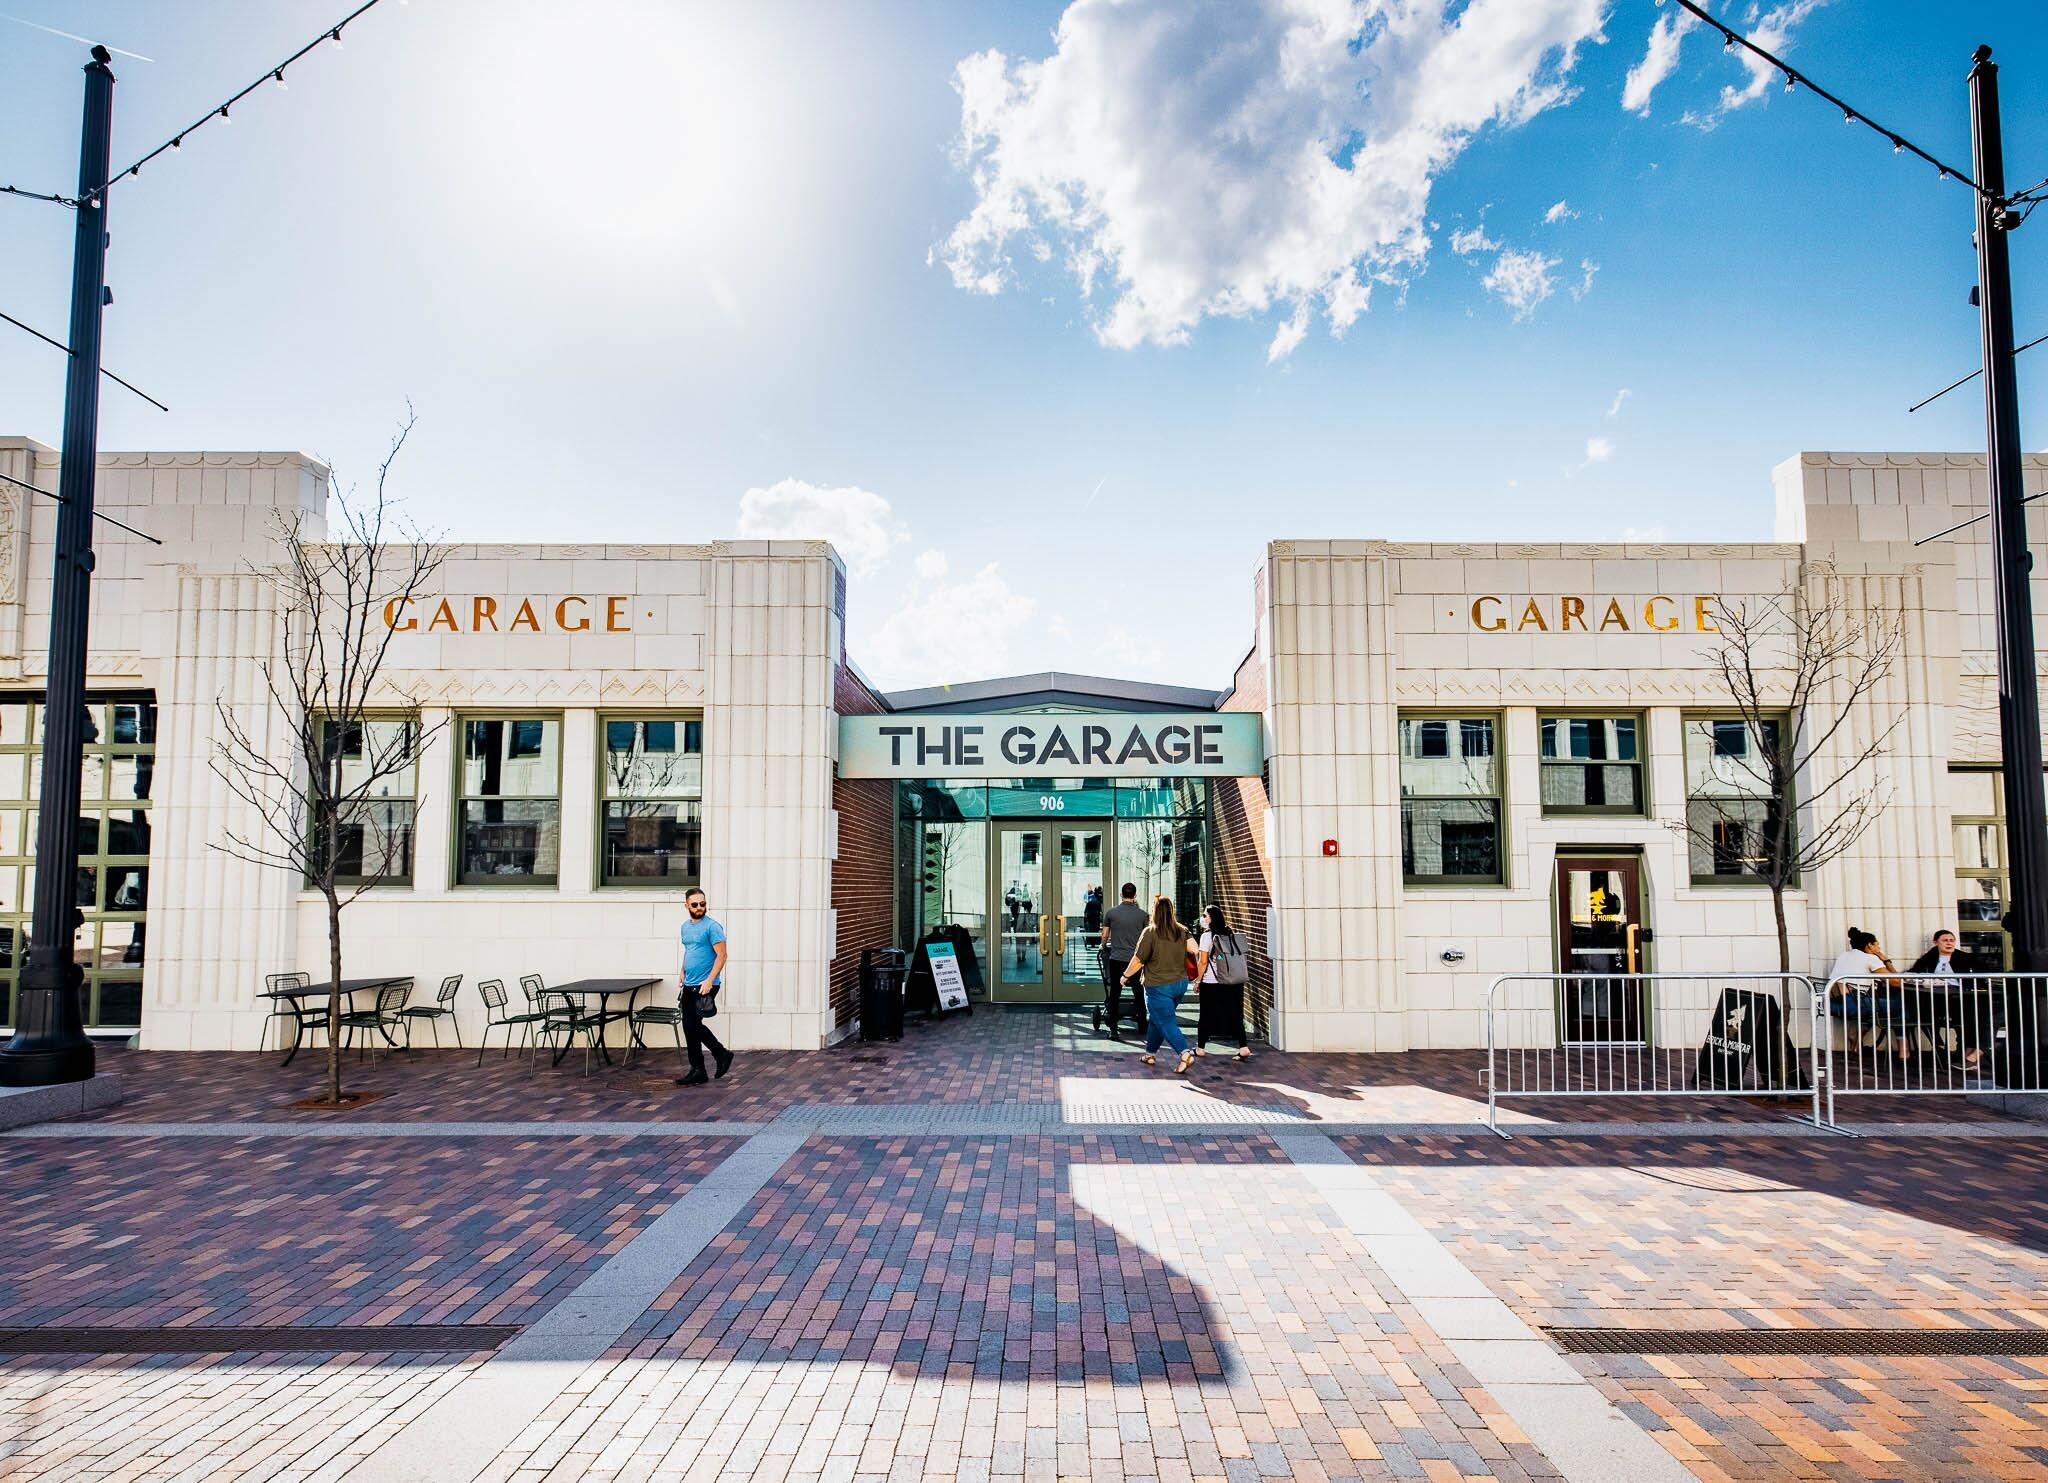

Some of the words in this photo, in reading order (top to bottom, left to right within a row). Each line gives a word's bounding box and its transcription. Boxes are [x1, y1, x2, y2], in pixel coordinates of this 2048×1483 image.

[383, 596, 631, 632] GARAGE
[1471, 596, 1720, 631] GARAGE
[879, 726, 984, 765] THE
[1000, 724, 1224, 765] GARAGE
[1040, 796, 1065, 811] 906
